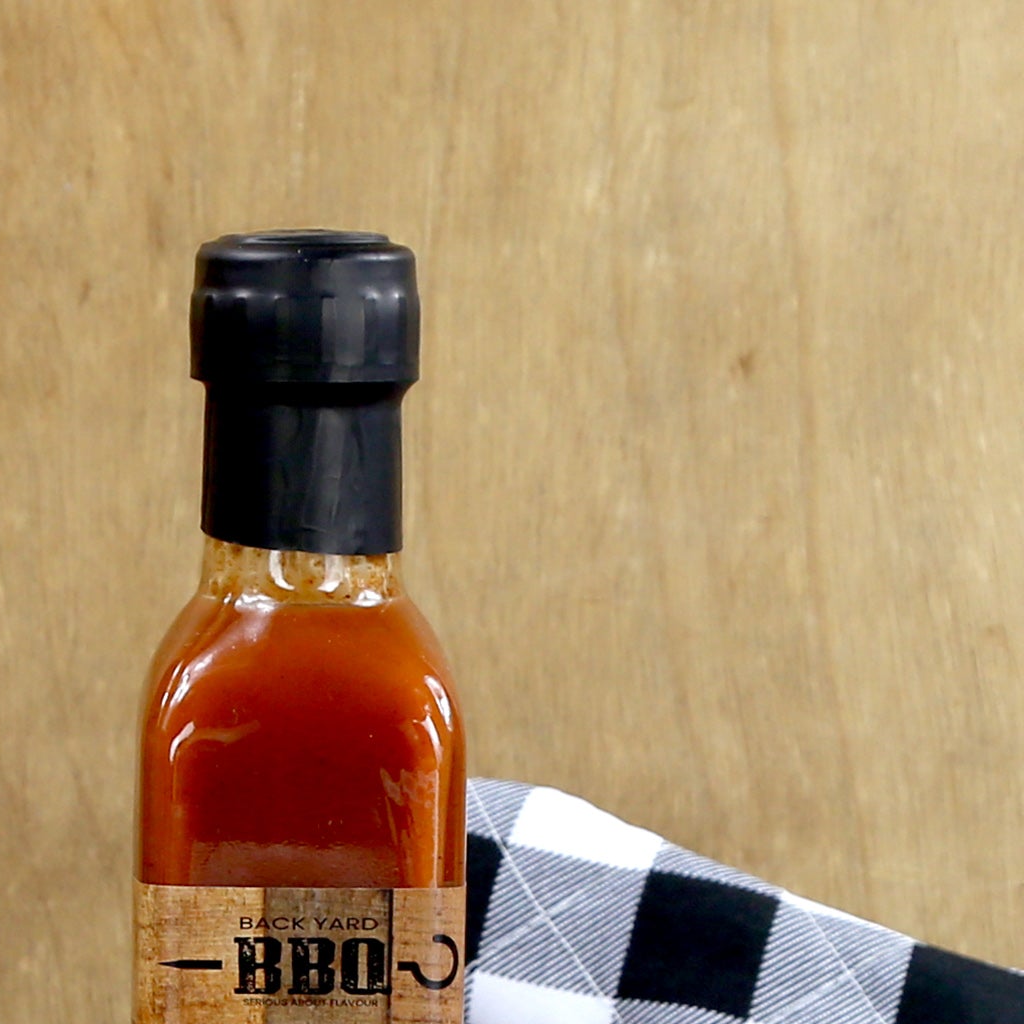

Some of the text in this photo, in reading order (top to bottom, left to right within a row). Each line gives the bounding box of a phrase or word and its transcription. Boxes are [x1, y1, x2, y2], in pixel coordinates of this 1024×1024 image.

[239, 916, 379, 931] BACK YARD
[233, 936, 393, 995] BBQ
[243, 998, 379, 1008] SERIOUS ABOUT FLAVOUR
